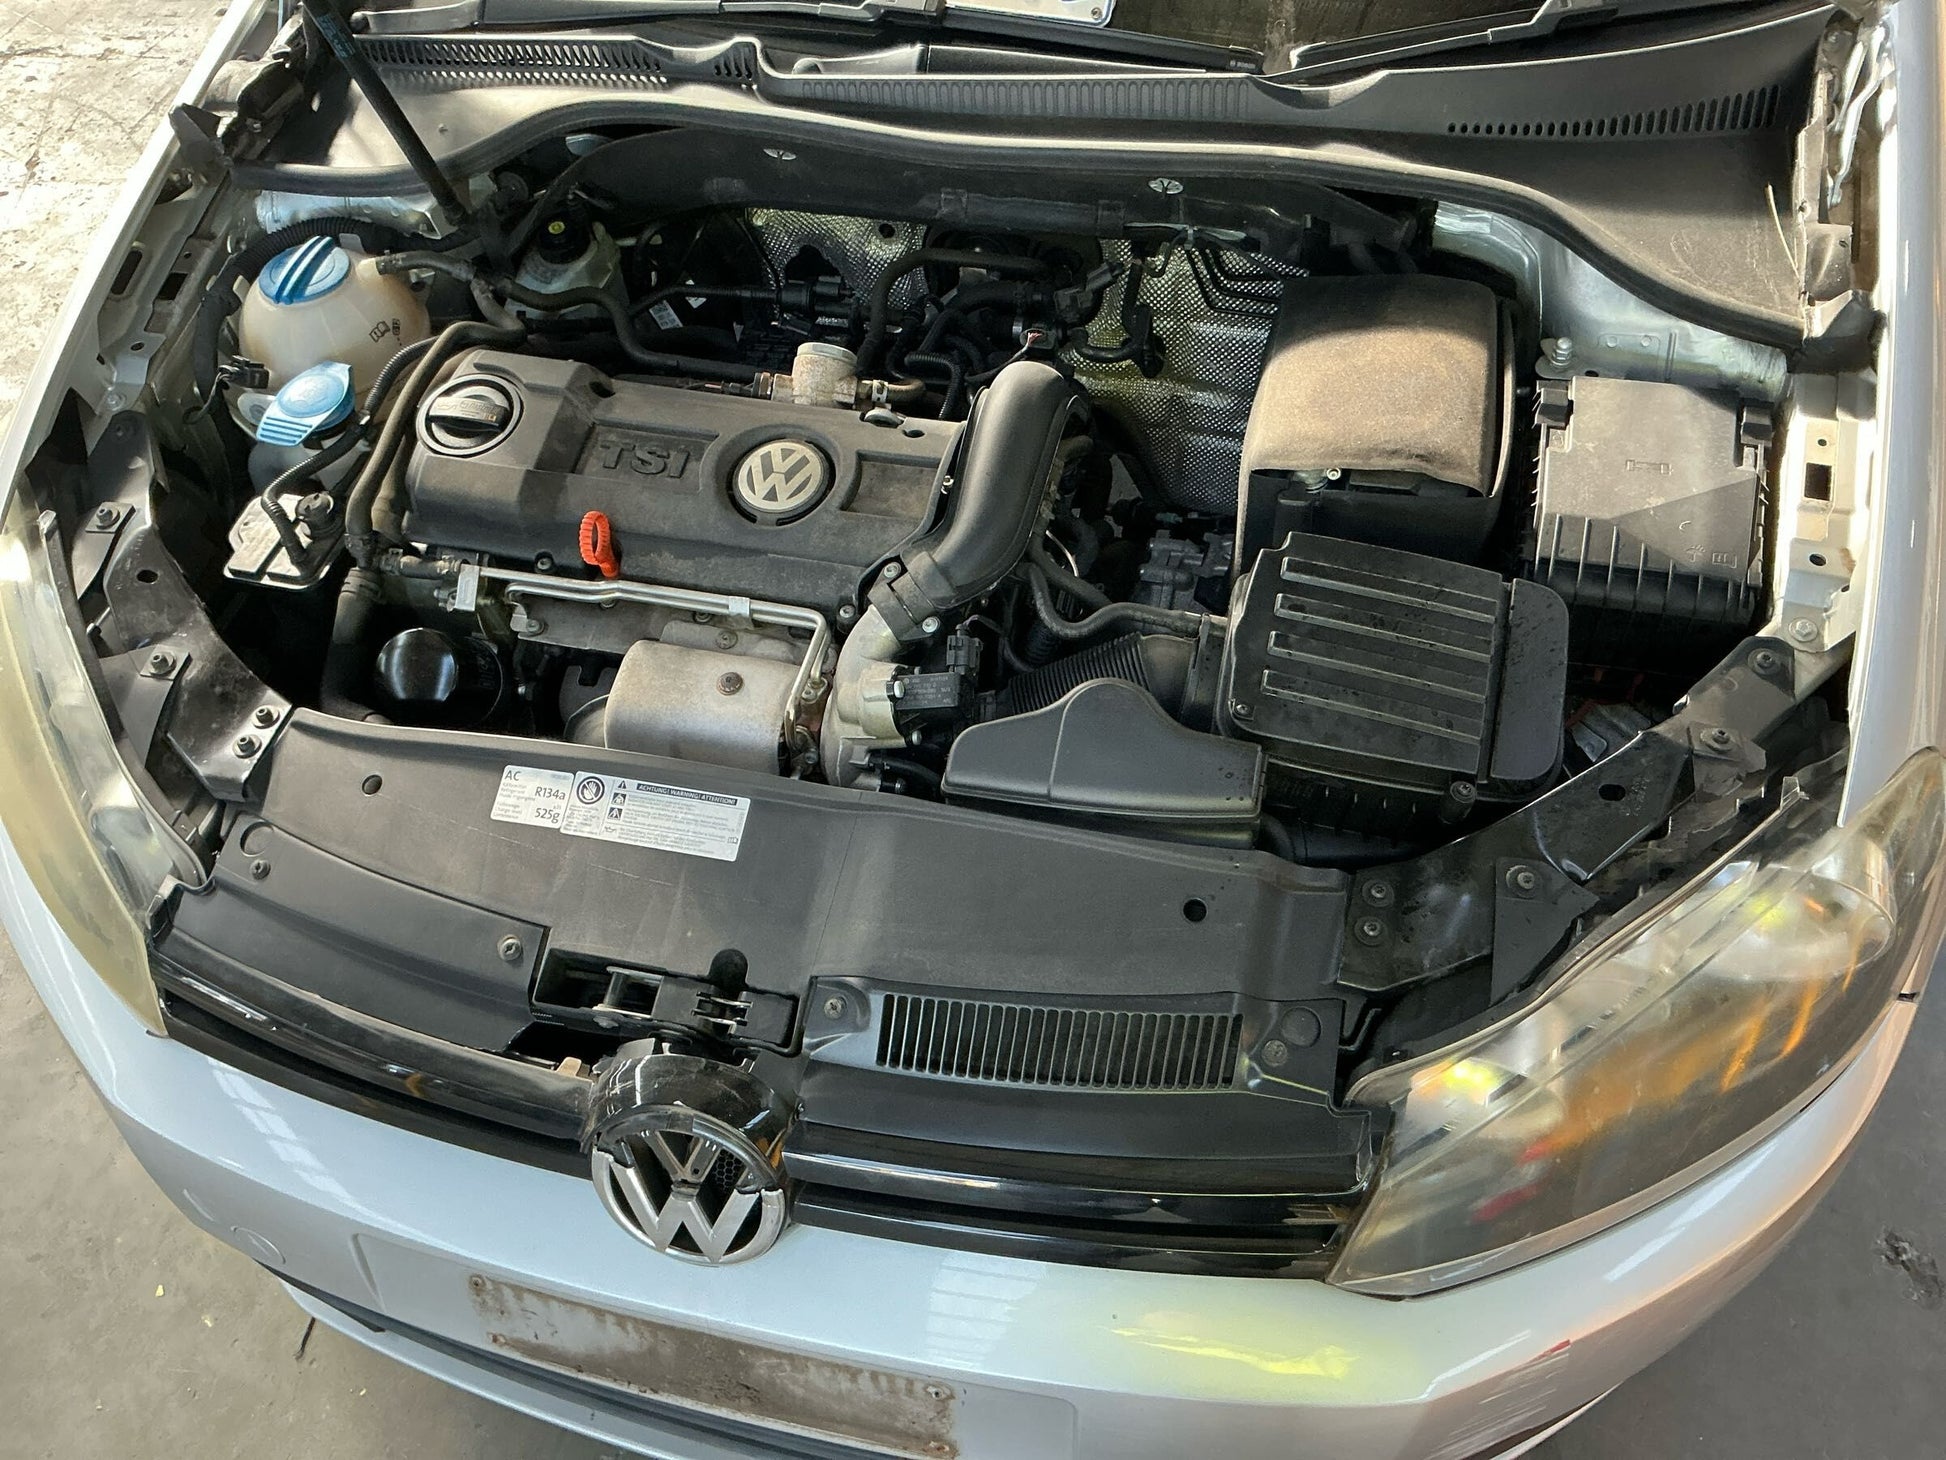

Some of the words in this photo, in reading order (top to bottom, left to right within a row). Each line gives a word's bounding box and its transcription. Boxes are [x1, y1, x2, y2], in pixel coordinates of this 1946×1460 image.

[600, 441, 690, 478] TSI
[738, 439, 823, 512] VW
[504, 770, 521, 781] AC
[534, 786, 566, 800] R134a
[638, 784, 669, 794] ACHTUNG!
[670, 790, 701, 799] WARNING!
[700, 795, 736, 805] ATTENTION!
[534, 807, 560, 823] 525g
[591, 1113, 785, 1267] VW
